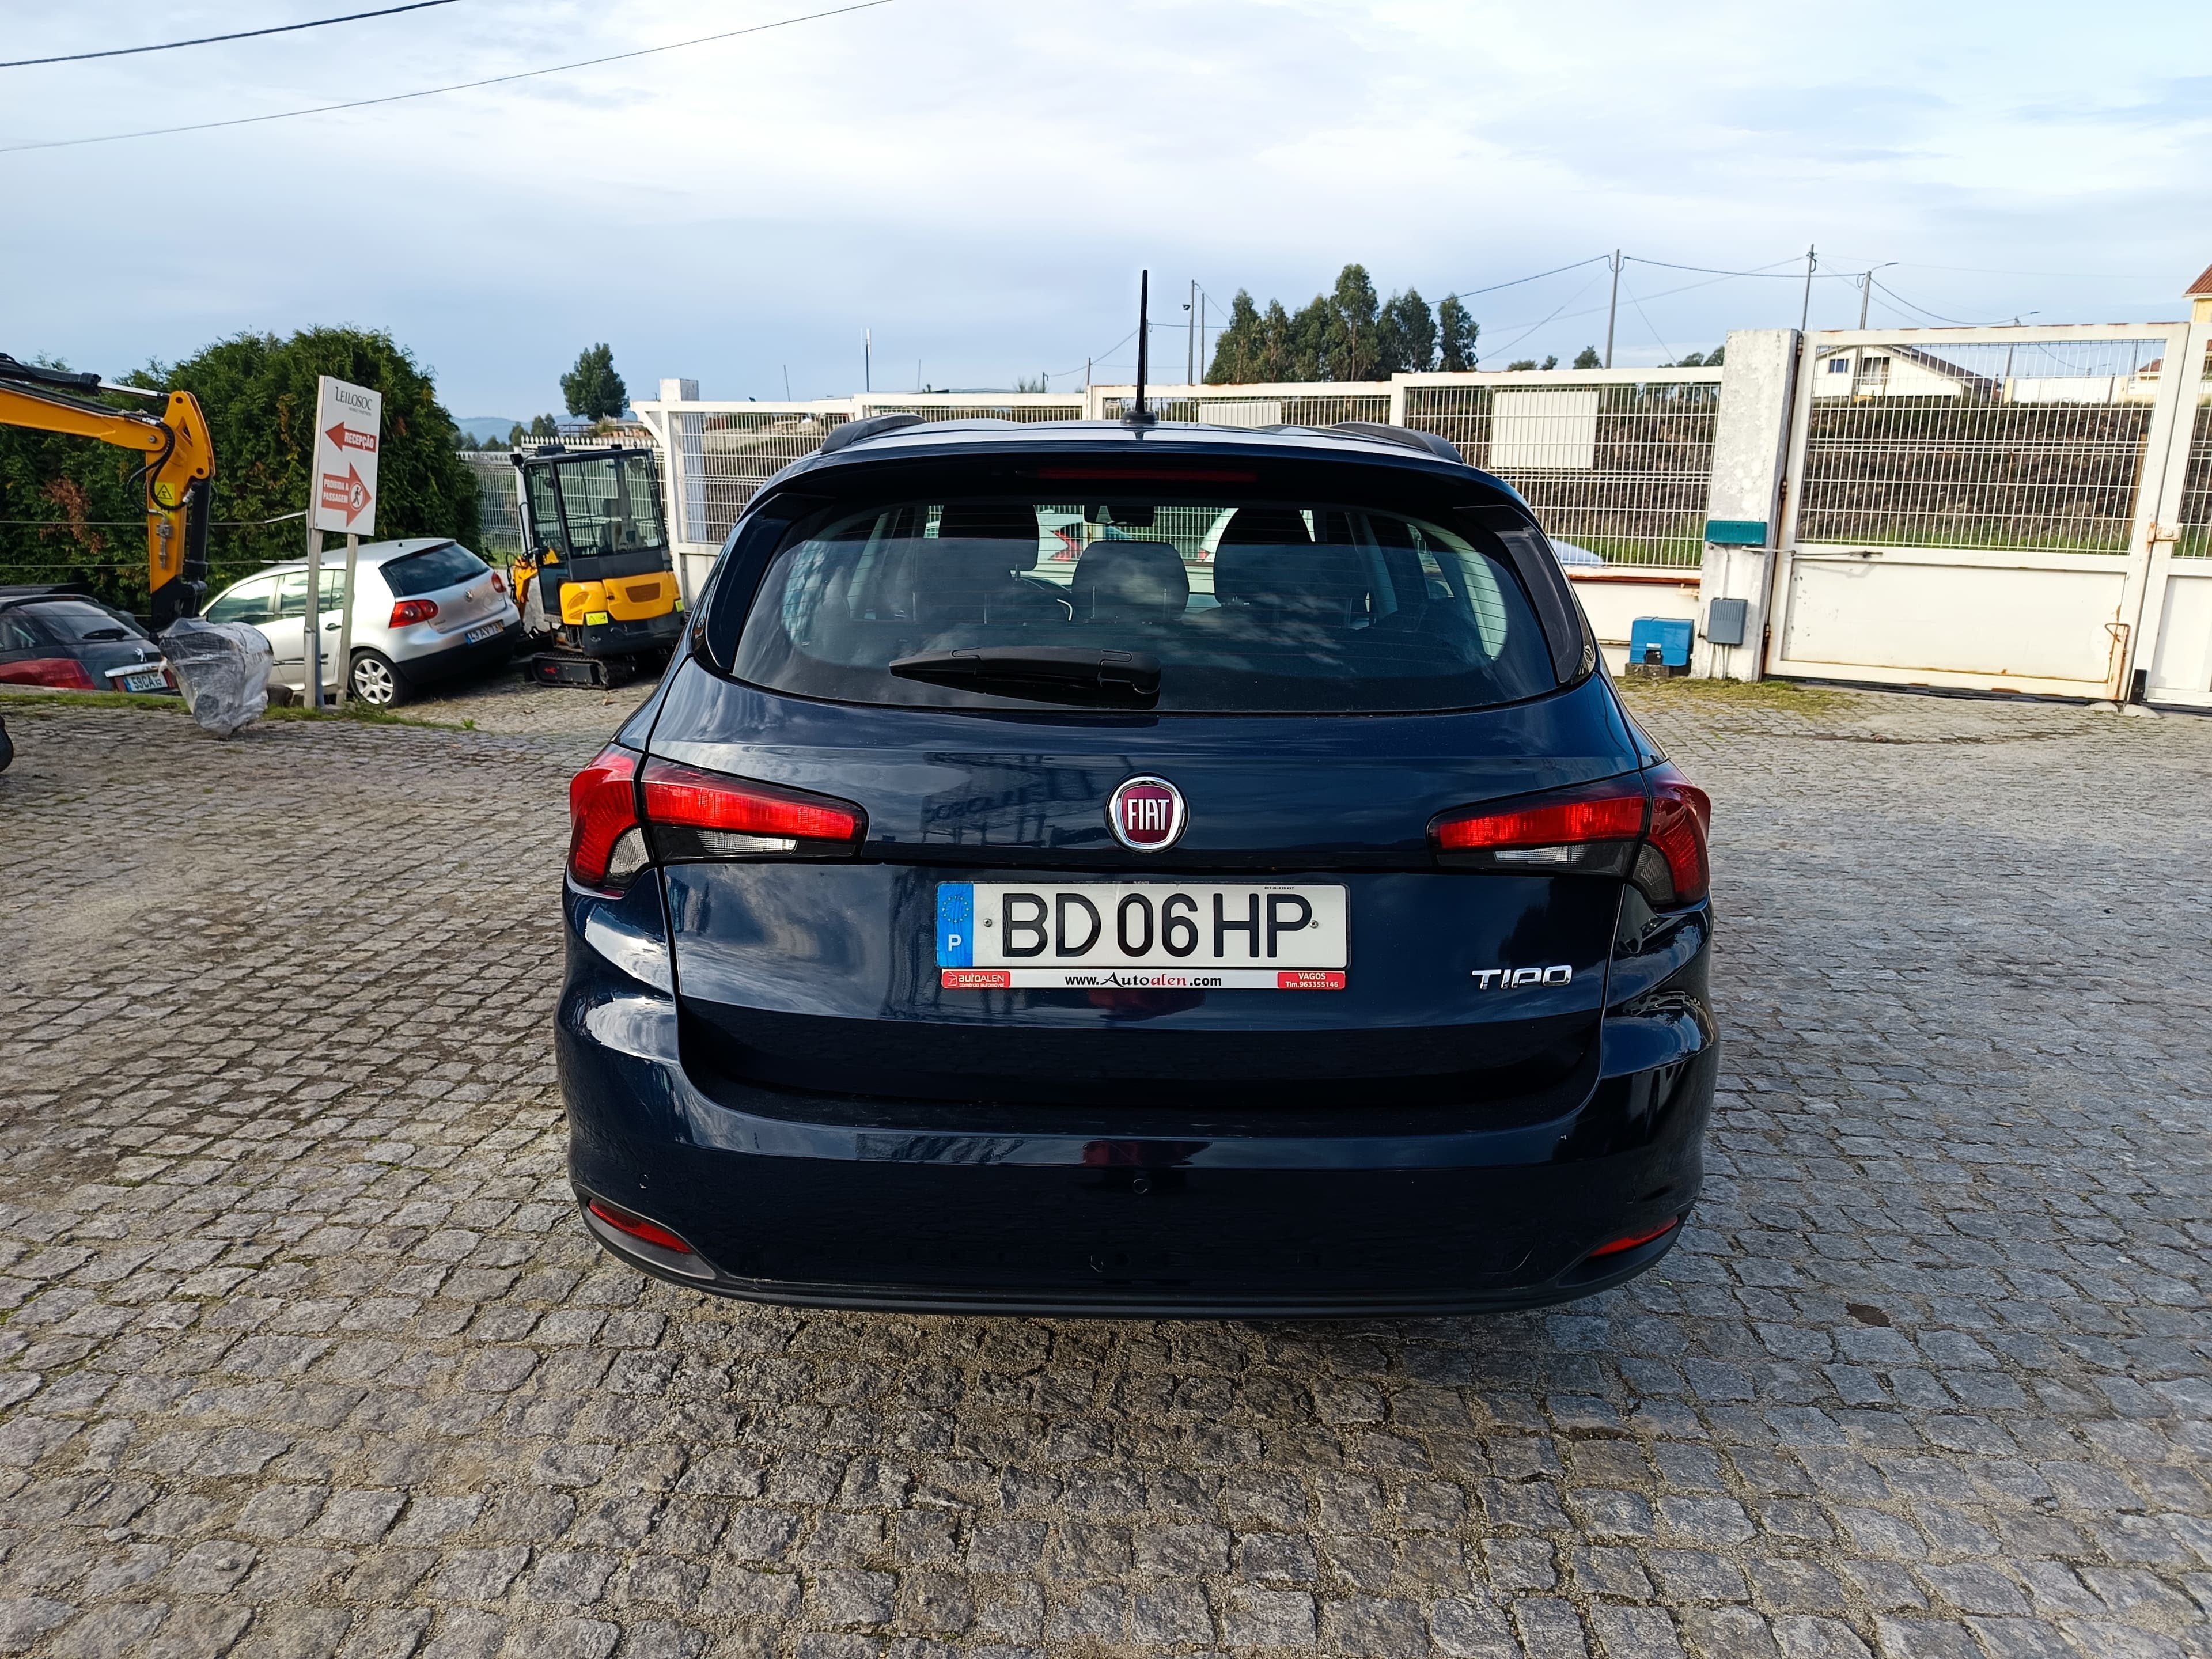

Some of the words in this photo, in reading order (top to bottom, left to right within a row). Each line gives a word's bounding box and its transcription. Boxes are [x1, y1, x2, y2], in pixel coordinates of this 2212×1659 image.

[335, 386, 372, 411] LEILOSOC
[344, 431, 374, 449] RECEPÇÃO
[1127, 798, 1169, 831] FIAT
[948, 934, 962, 952] P
[1472, 965, 1573, 990] TIPO
